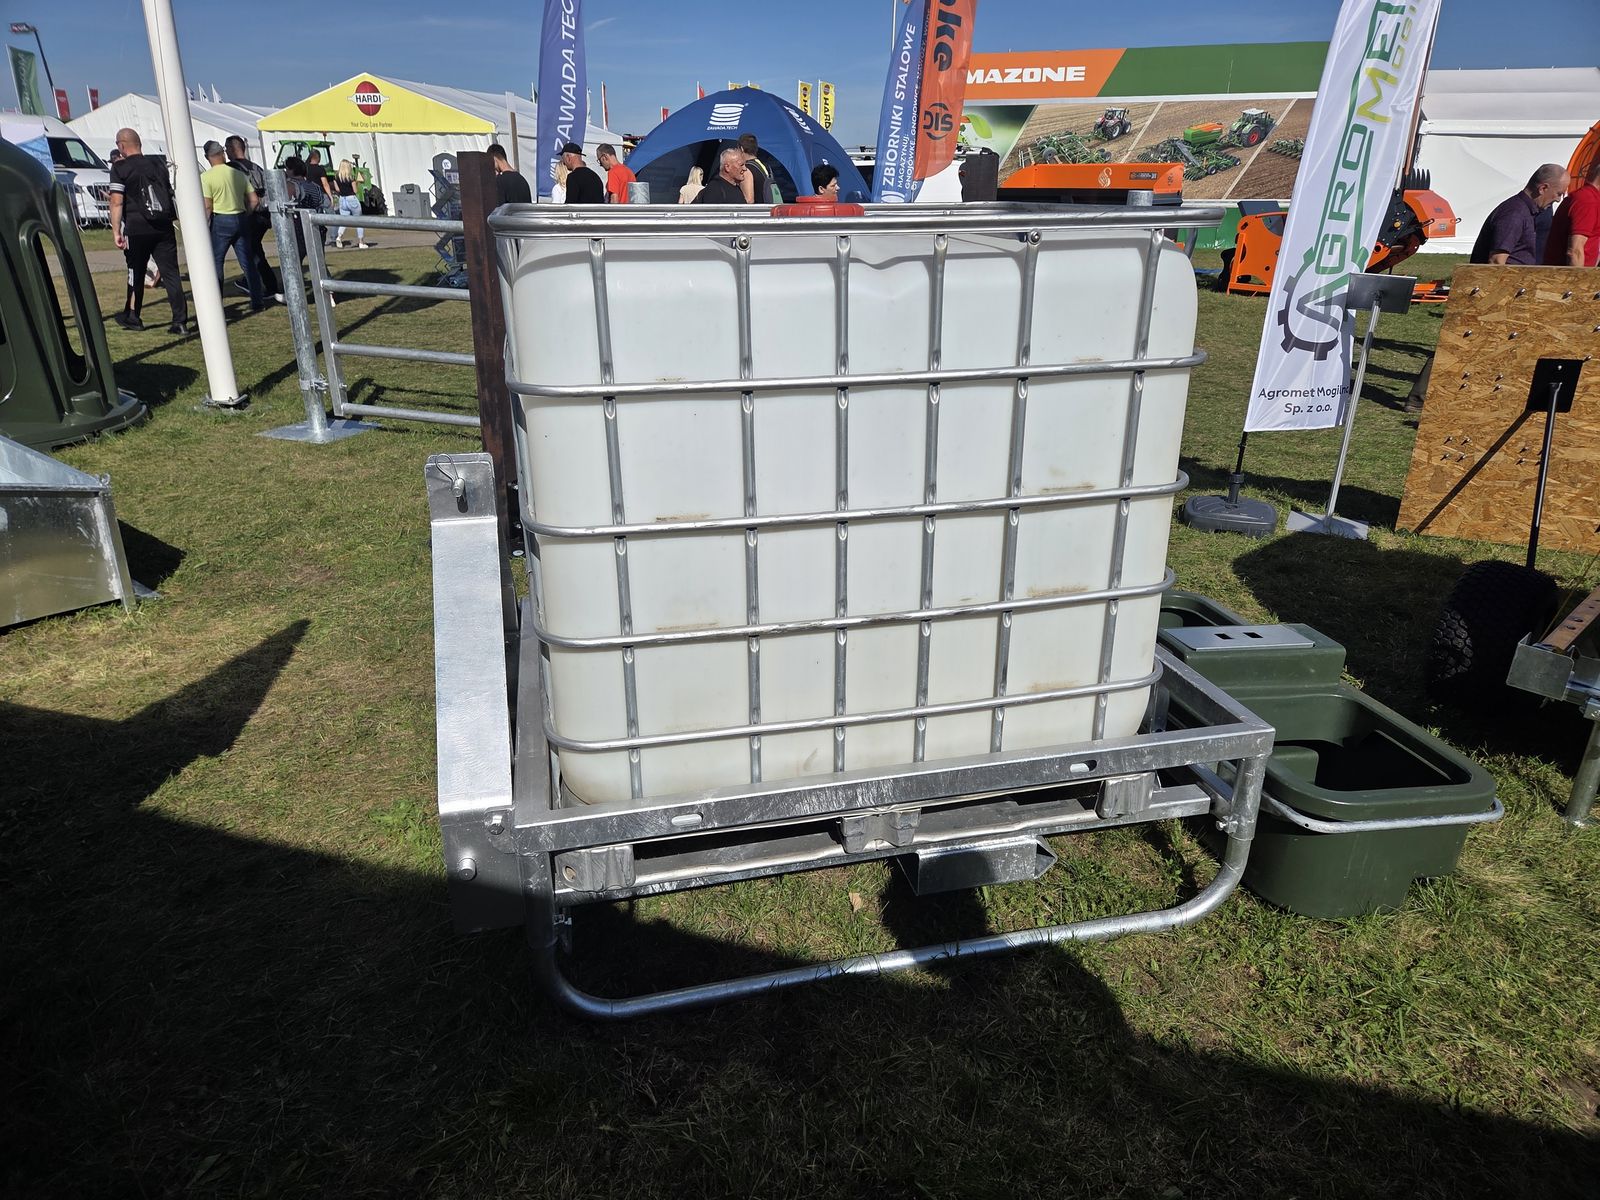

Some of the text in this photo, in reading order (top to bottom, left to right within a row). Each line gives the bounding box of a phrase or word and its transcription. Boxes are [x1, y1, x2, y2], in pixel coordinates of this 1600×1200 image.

[965, 66, 1086, 84] MAZONE
[355, 95, 382, 103] HARDI
[883, 23, 916, 187] ZBIORNIKI STALOWE
[823, 97, 832, 132] HARD
[897, 133, 909, 188] MAGAZYNUJ:
[1258, 388, 1315, 400] Agromet
[1284, 403, 1303, 415] Sp.
[1316, 404, 1332, 412] o.o.
